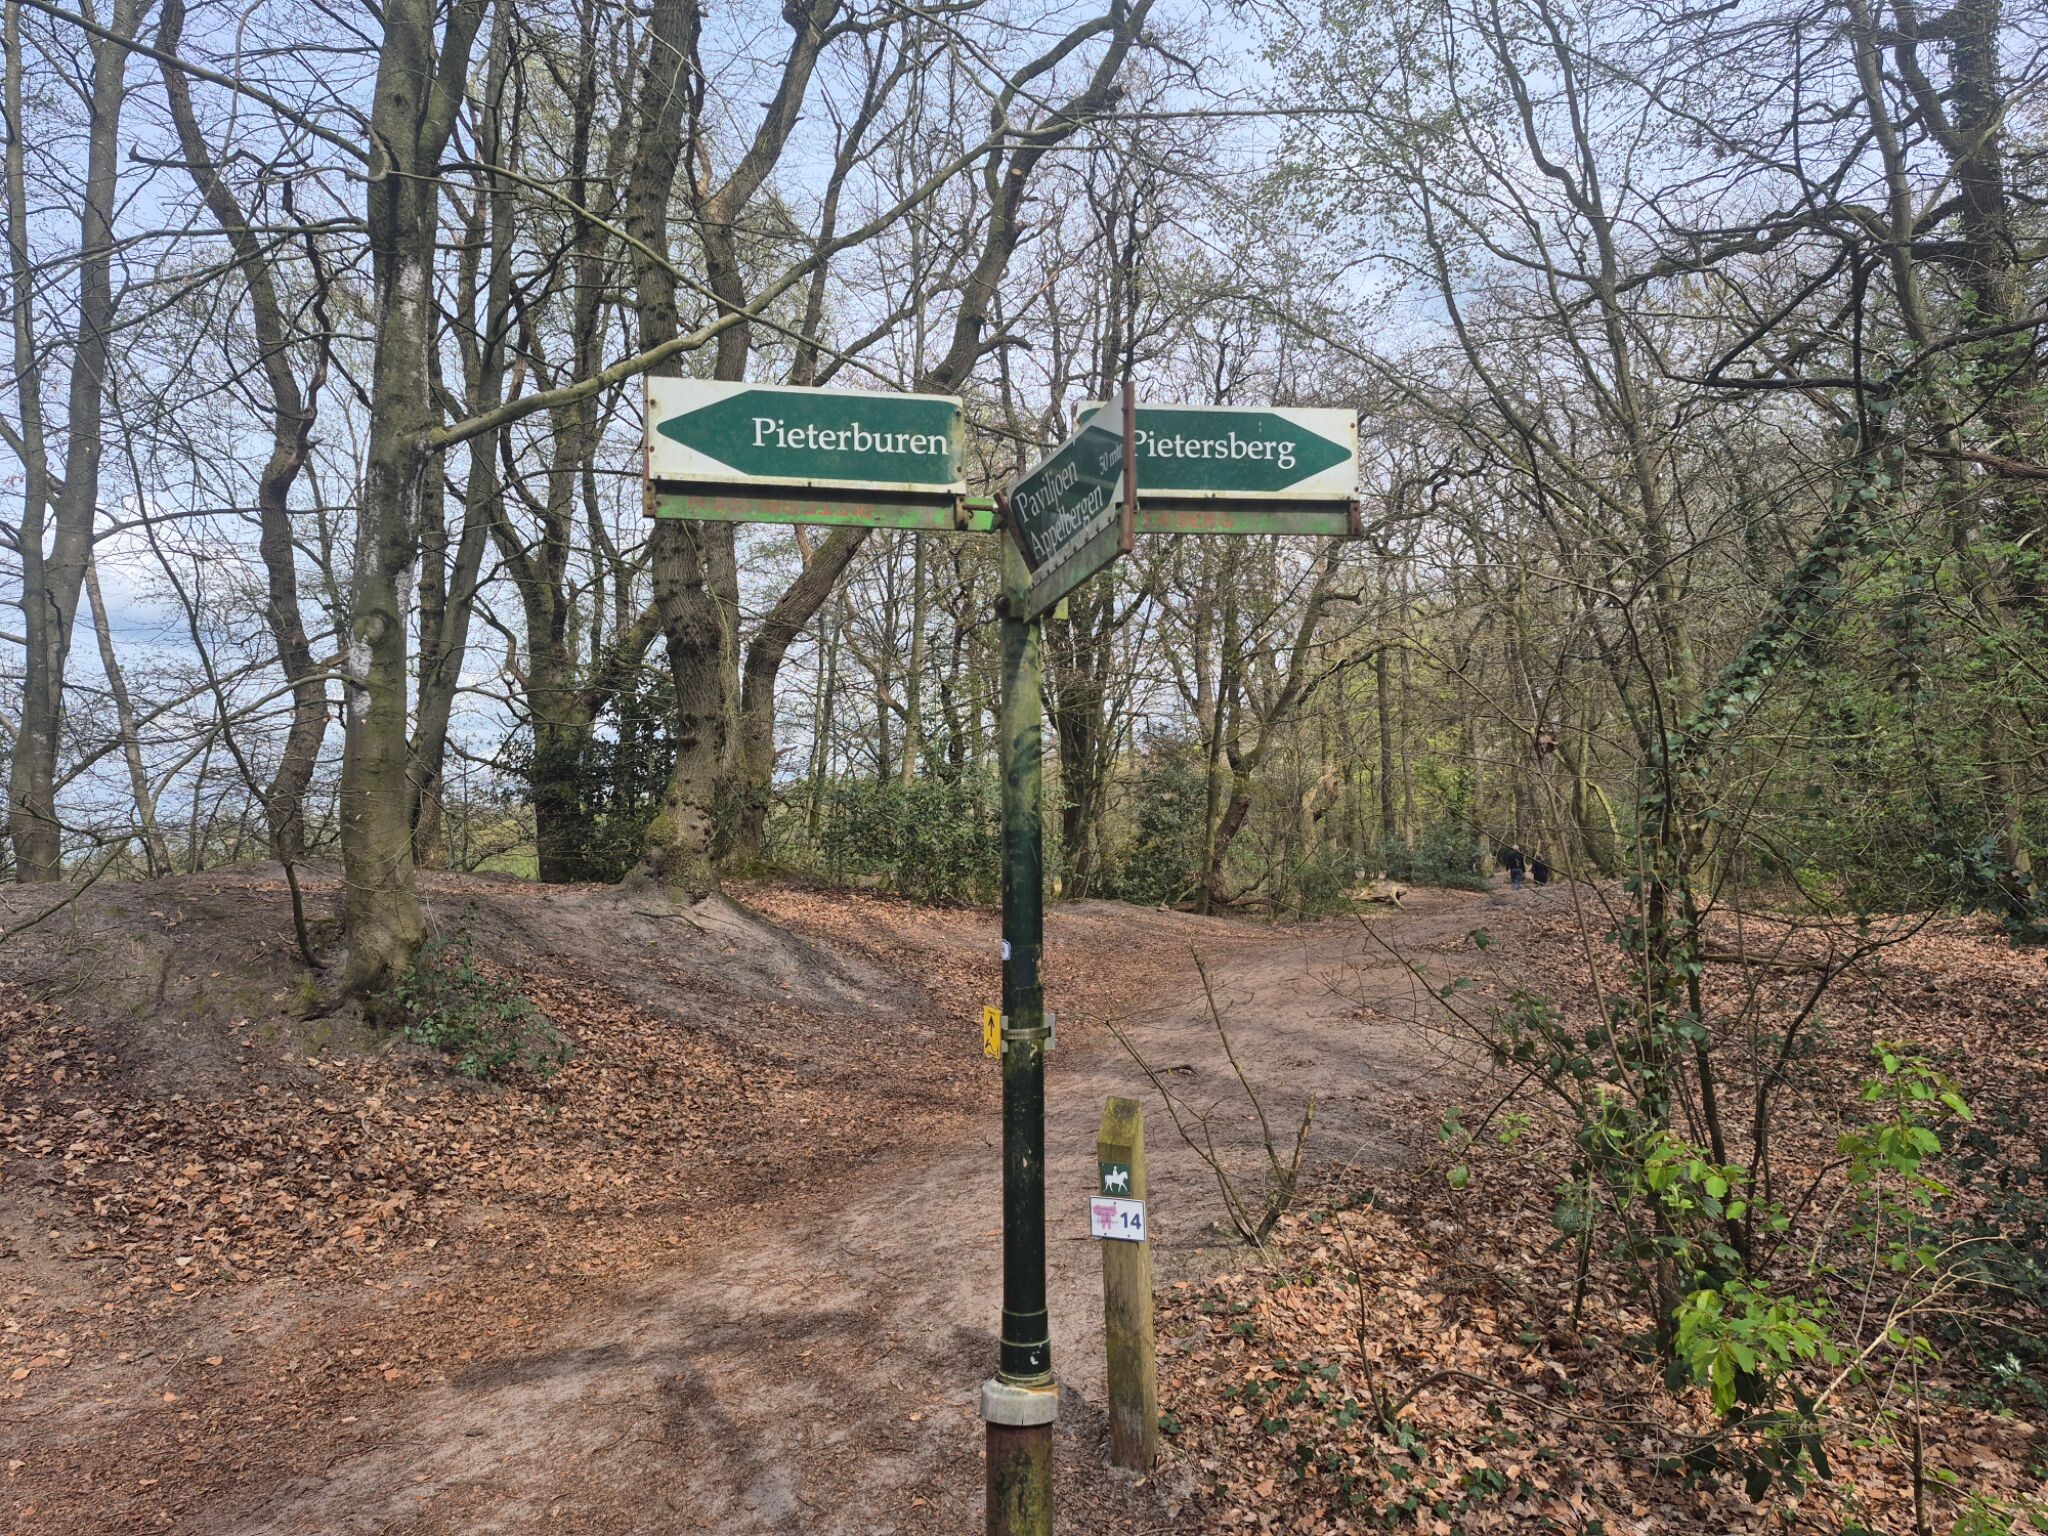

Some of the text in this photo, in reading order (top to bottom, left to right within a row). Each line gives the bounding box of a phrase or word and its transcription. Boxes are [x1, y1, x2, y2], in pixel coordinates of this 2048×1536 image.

[751, 417, 949, 456] Pieterburen
[1134, 429, 1297, 469] Pietersberg
[1014, 460, 1079, 524] Paviljoen
[1030, 484, 1104, 560] Appelbergen
[1120, 1211, 1142, 1230] 14
